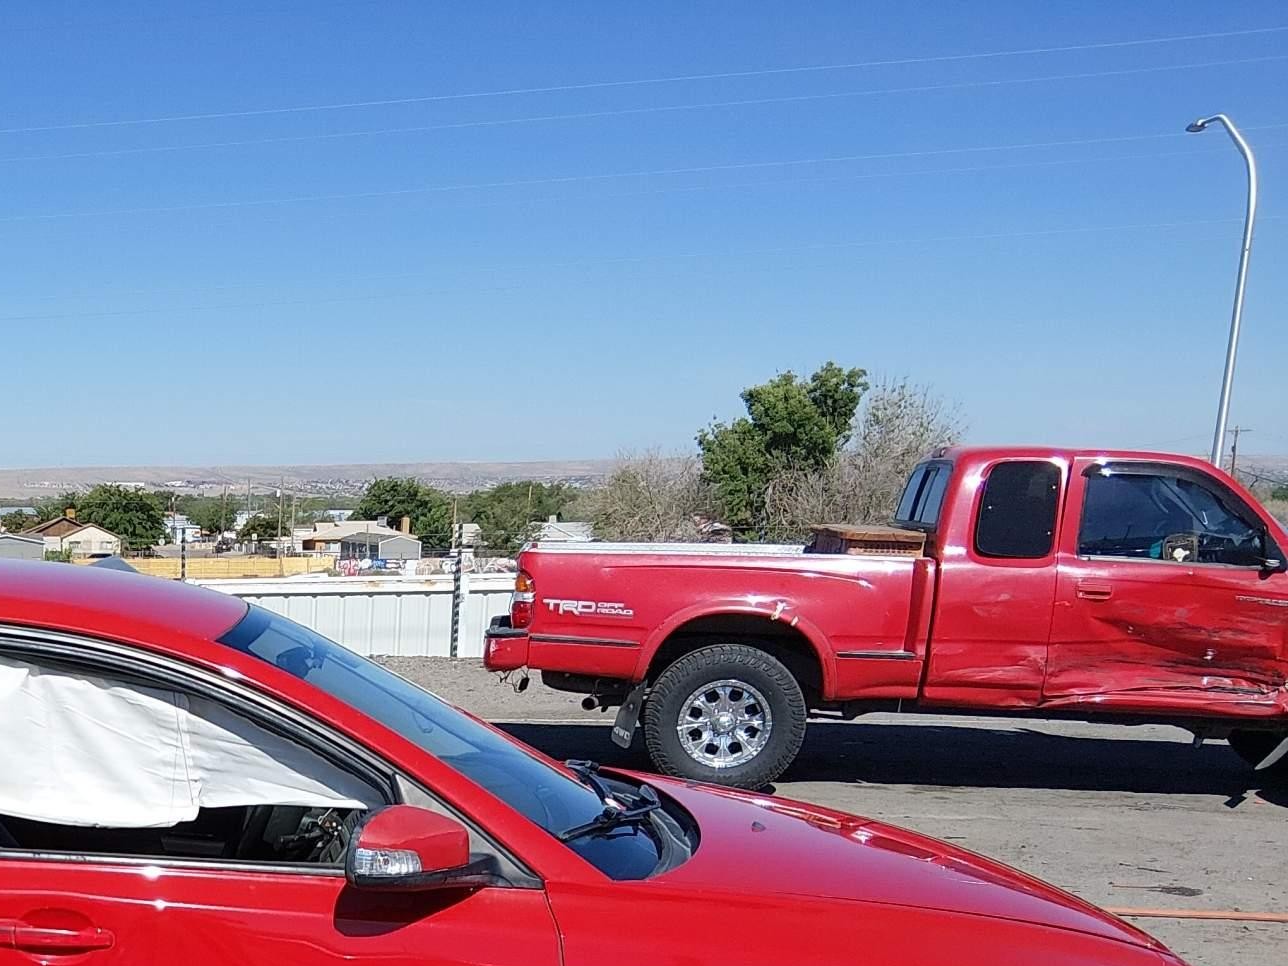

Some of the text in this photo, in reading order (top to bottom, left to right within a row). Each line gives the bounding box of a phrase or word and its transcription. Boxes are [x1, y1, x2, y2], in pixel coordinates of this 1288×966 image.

[543, 599, 625, 615] TRD OFF
[597, 607, 634, 616] ROAD
